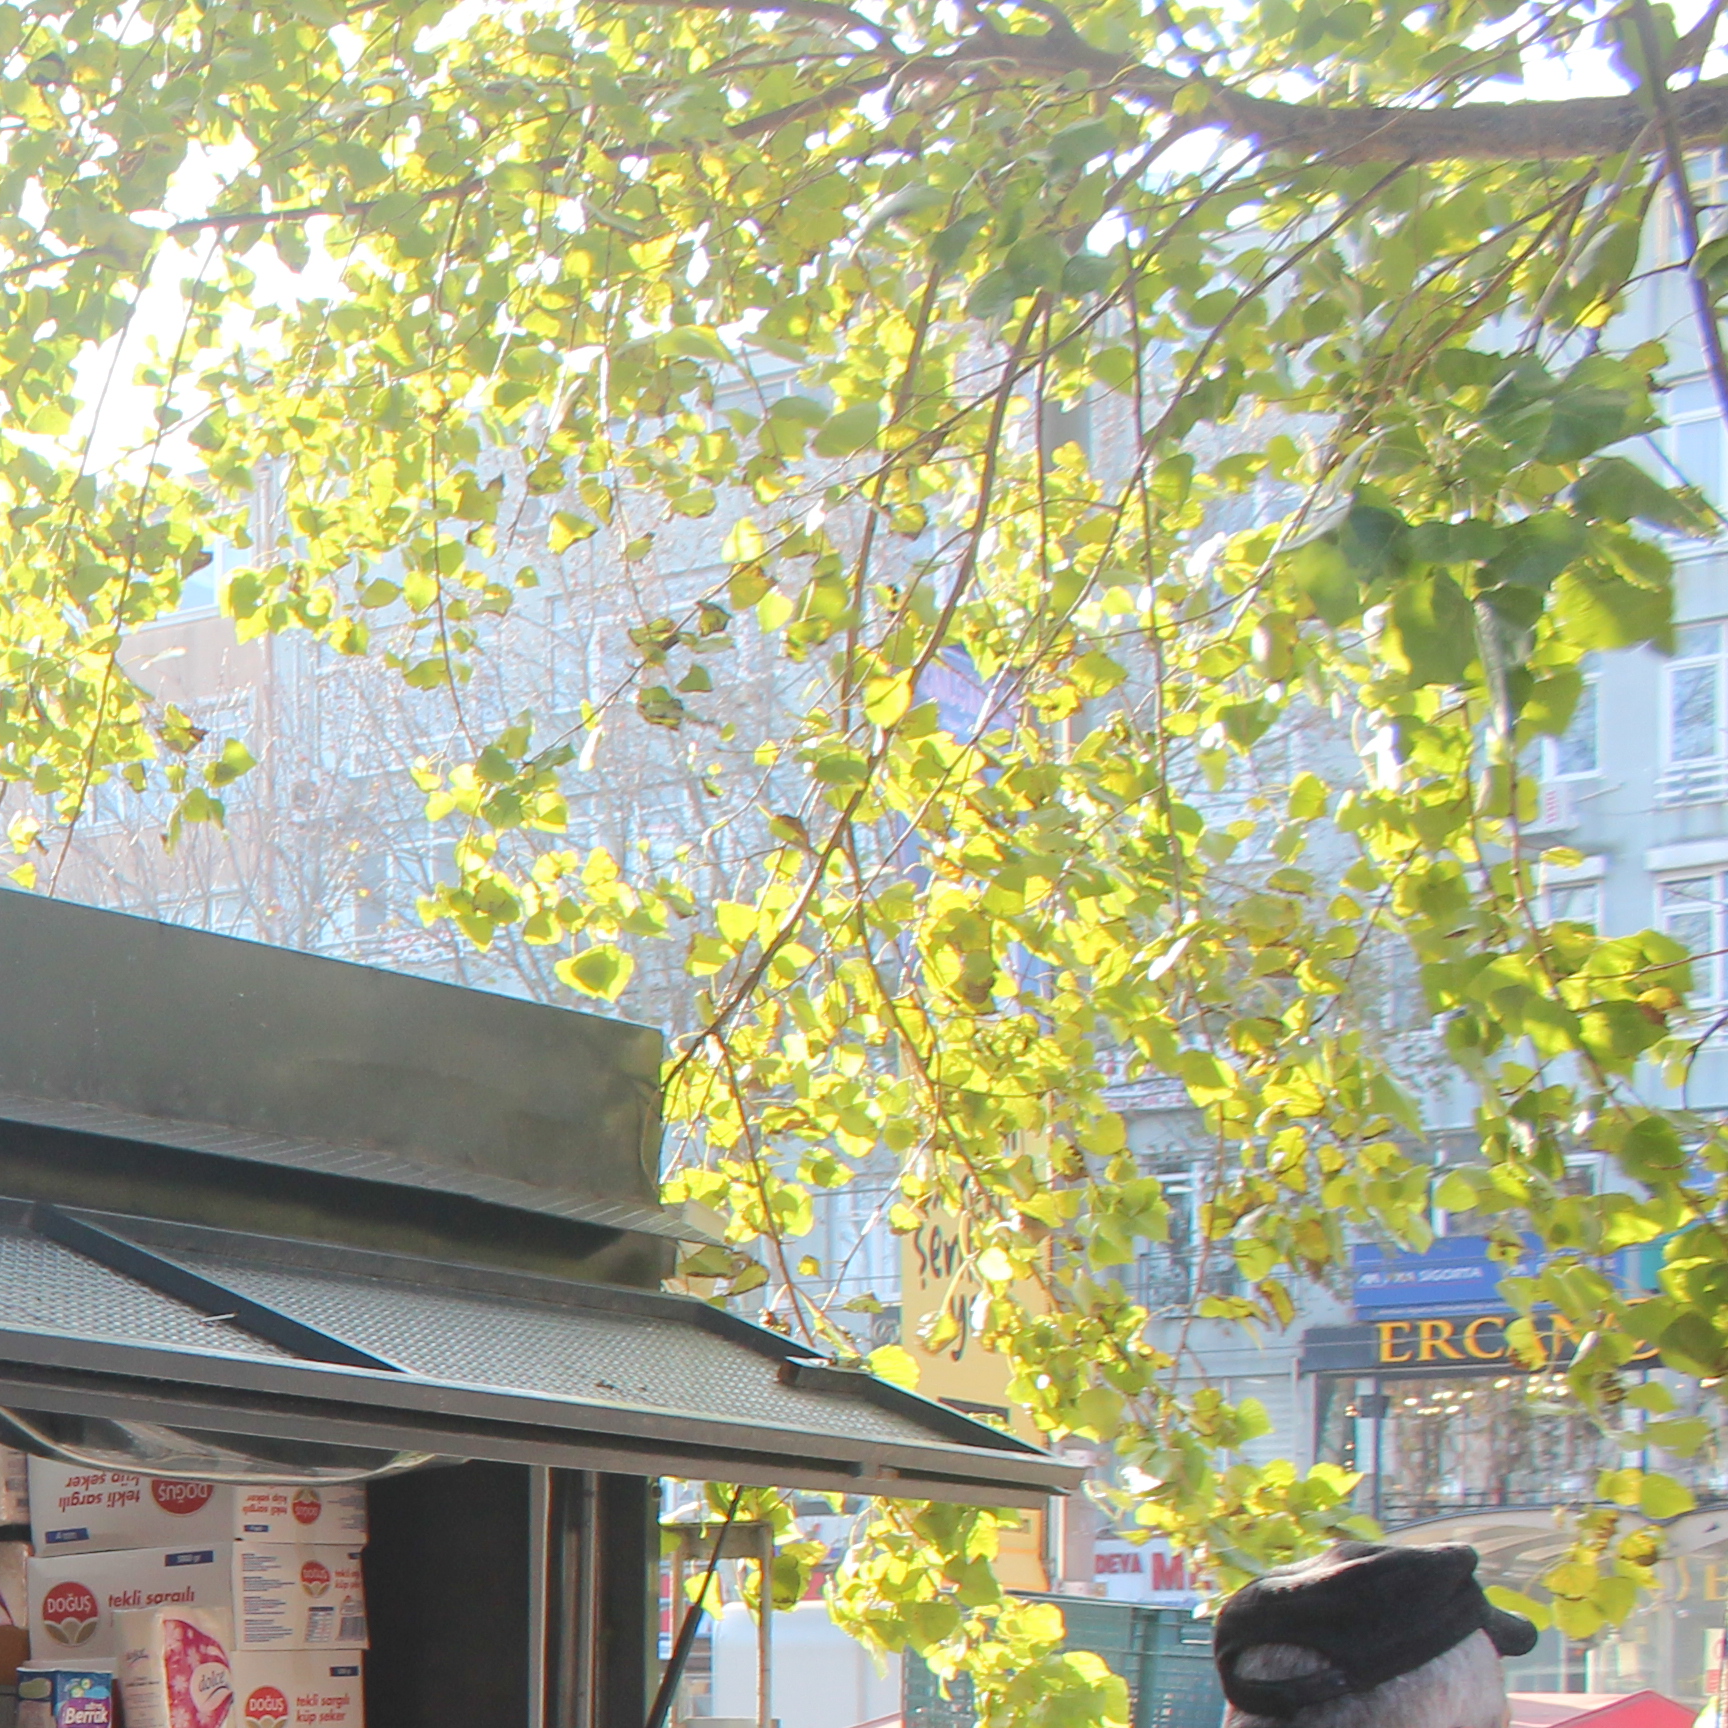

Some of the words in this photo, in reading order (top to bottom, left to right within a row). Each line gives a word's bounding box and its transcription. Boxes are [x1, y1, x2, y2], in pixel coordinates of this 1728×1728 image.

[1095, 1553, 1142, 1573] DEVA
[47, 1593, 92, 1615] DOĞUŞ
[108, 1589, 141, 1608] tekli
[250, 1697, 285, 1714] DOĞUŞ
